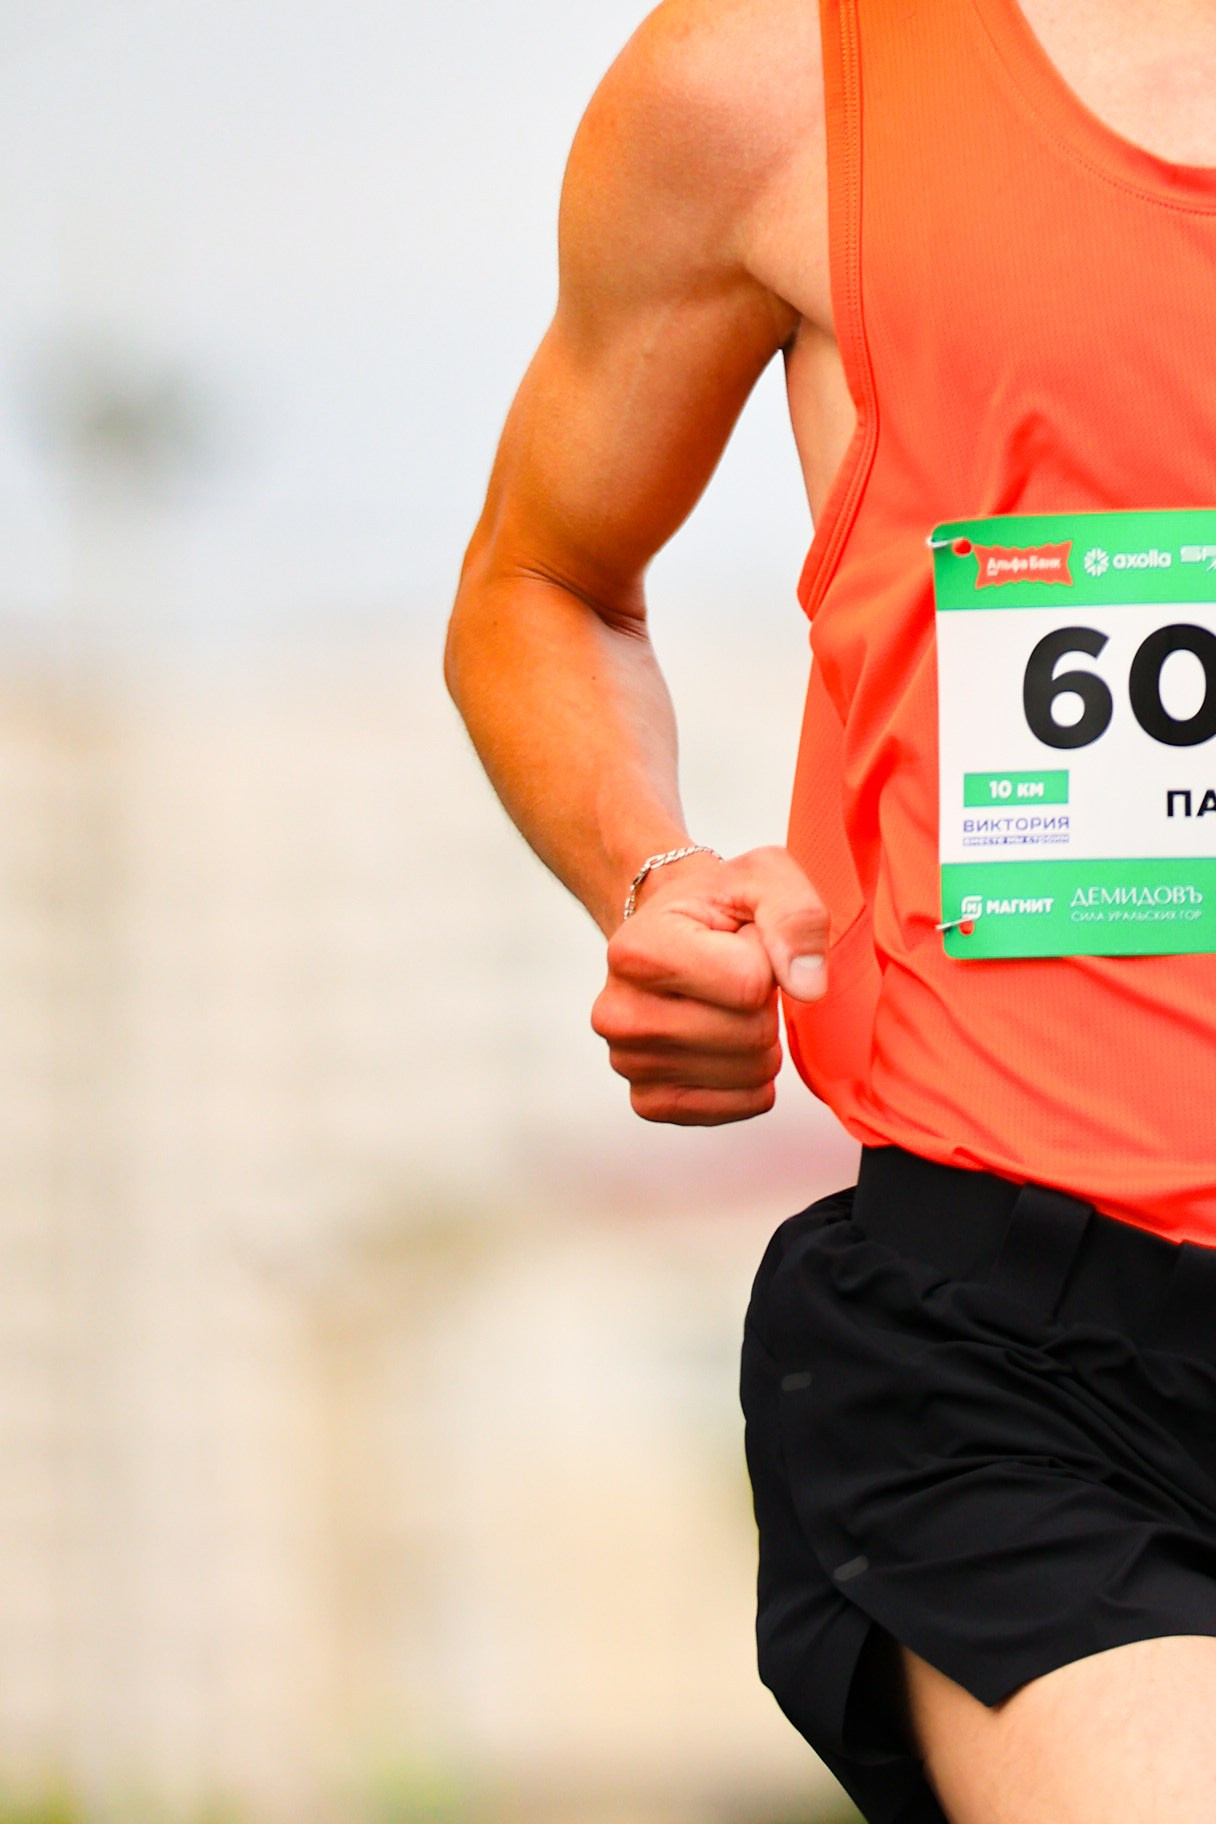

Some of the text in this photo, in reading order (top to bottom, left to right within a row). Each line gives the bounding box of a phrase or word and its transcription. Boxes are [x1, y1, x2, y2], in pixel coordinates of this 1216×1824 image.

[988, 779, 1013, 799] 10
[962, 816, 1070, 833] ВИКТОРИЯ
[1070, 885, 1203, 907] ДЕМИДОВЪ
[985, 898, 1055, 915] МАГНИТ
